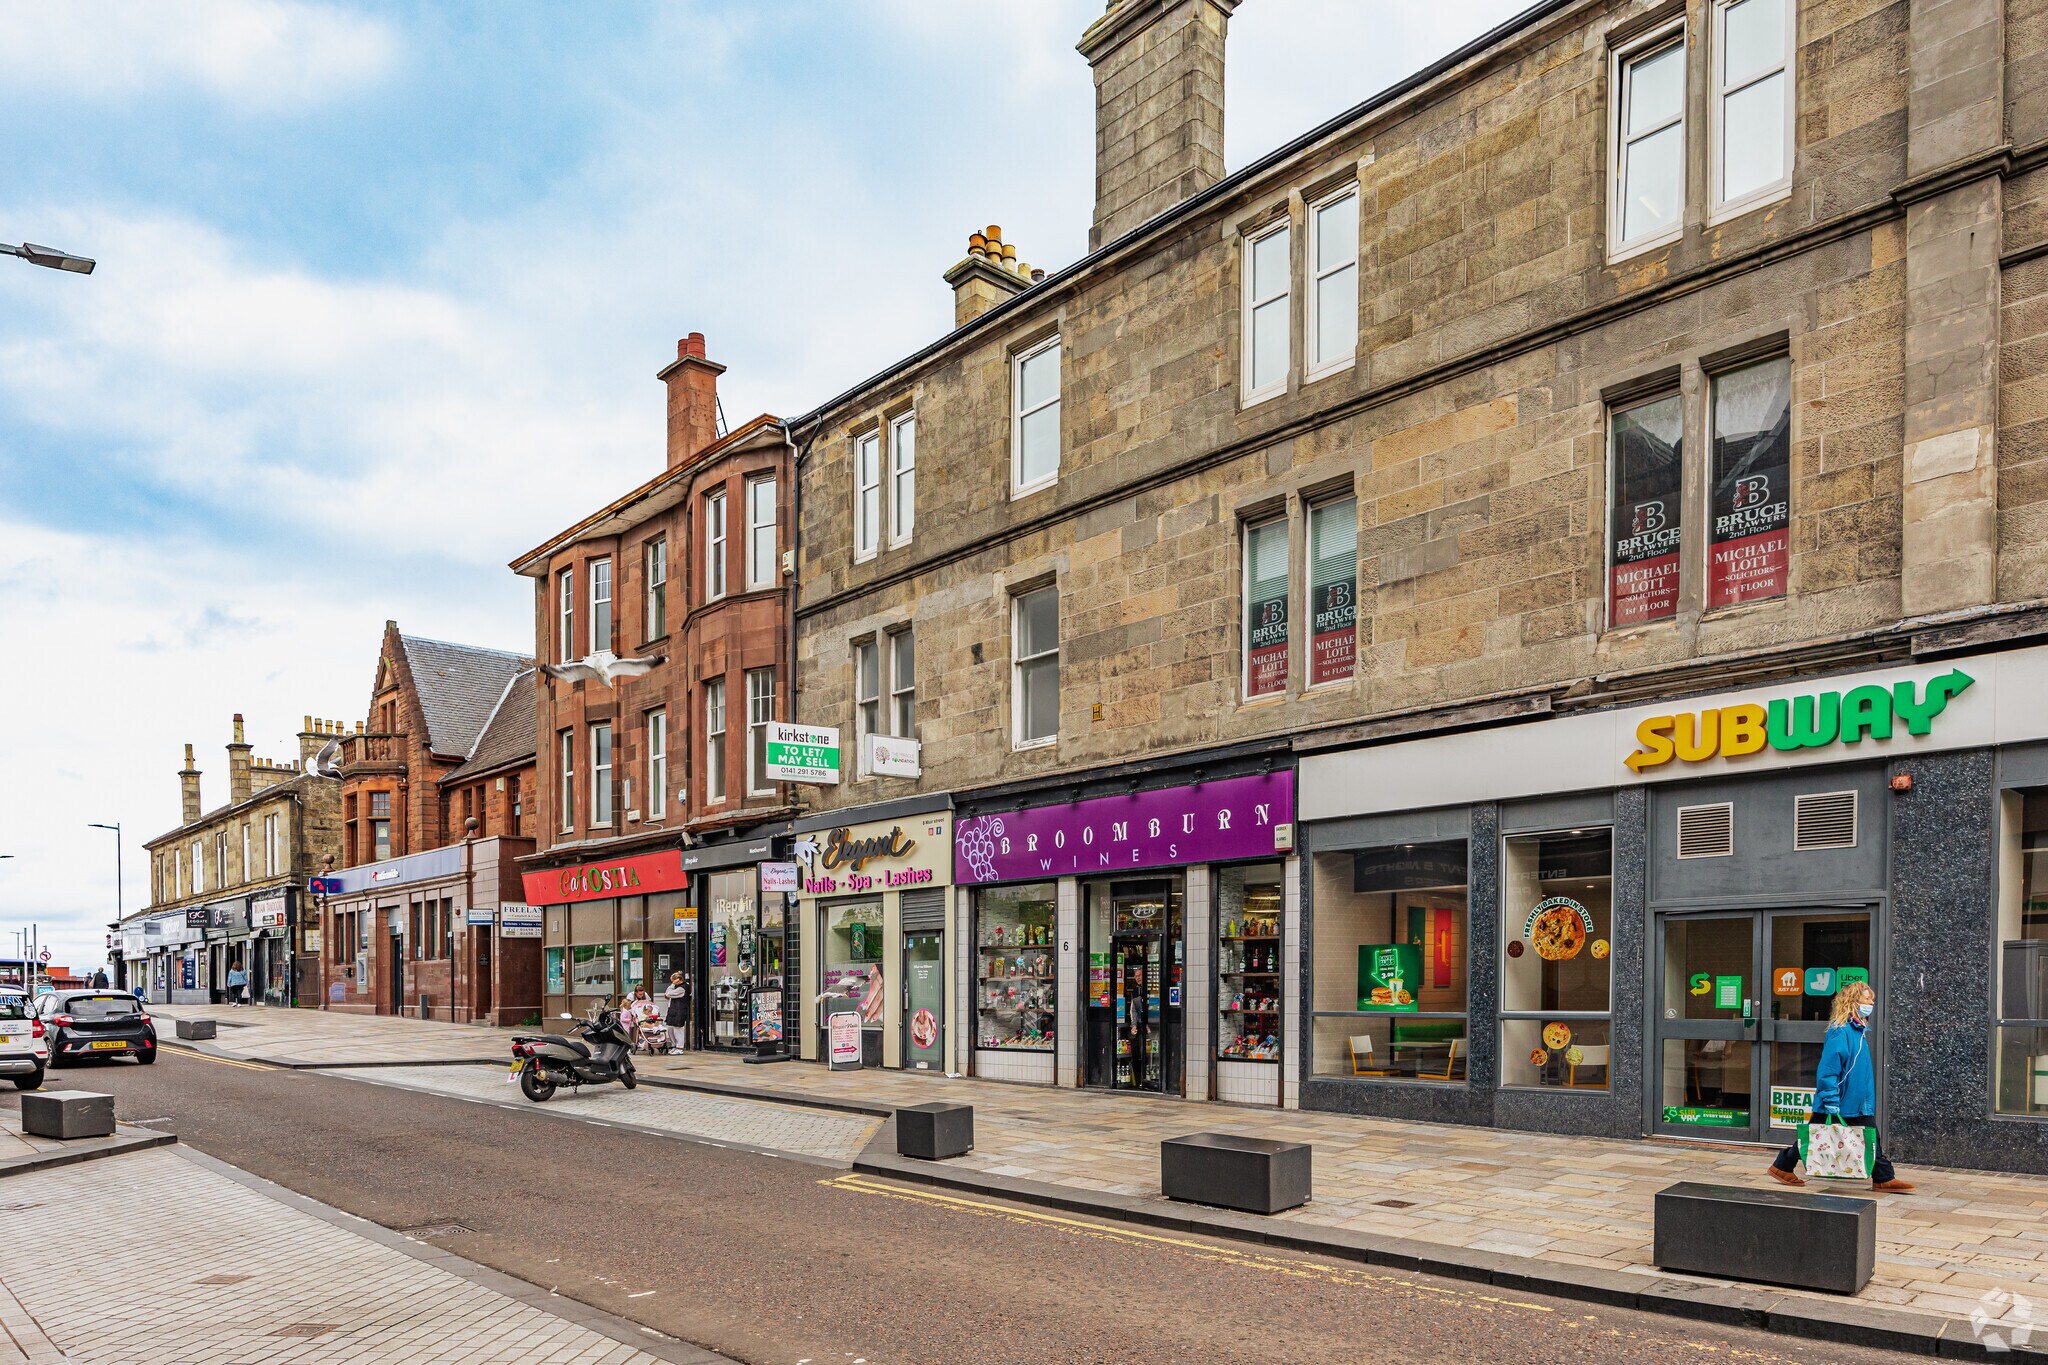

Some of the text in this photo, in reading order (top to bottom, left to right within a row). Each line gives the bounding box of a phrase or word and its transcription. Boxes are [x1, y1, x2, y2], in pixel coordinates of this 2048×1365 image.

[1716, 501, 1787, 528] BRUCE
[1715, 513, 1787, 535] THE LAWYERS
[1728, 524, 1773, 539] 2nd Floor
[1617, 526, 1681, 552] BRUCE
[1617, 538, 1681, 557] THE LAWYERS
[1628, 547, 1669, 562] 2nd Floor
[1715, 539, 1787, 564] MICHAEL
[1731, 555, 1770, 573] LOTT
[1616, 562, 1680, 586] MICHAEL
[1631, 577, 1666, 593] LOTT
[1725, 578, 1774, 595] 1st FLOOR
[1639, 600, 1670, 612] FLOOR
[1330, 614, 1356, 626] LAWYER
[1265, 630, 1288, 640] LAWYE
[1316, 635, 1355, 652] MICHAE
[1252, 650, 1288, 666] MICHAE
[1326, 646, 1351, 659] LOTT
[1262, 661, 1284, 673] LOTT
[1623, 668, 1975, 774] SUBWAY
[778, 727, 829, 745] kirkstone
[783, 746, 825, 758] TO LET/
[778, 755, 829, 768] MAY SELL
[810, 769, 827, 777] 5786
[1001, 803, 1270, 856] BROOMBURN
[822, 826, 914, 871] Elegant
[1039, 844, 1178, 872] WINES
[588, 866, 640, 892] OSTIA
[804, 867, 932, 893] Nails Spa Lashes
[1134, 905, 1156, 916] OPEN
[1524, 897, 1594, 938] FRESHLY BAKED IN STORE
[1063, 941, 1069, 952] 6
[1840, 974, 1863, 982] Uber
[756, 1011, 778, 1020] PHONES
[1772, 1092, 1813, 1106] BREA
[1772, 1107, 1804, 1116] SERVED
[1780, 1114, 1804, 1124] FROM
